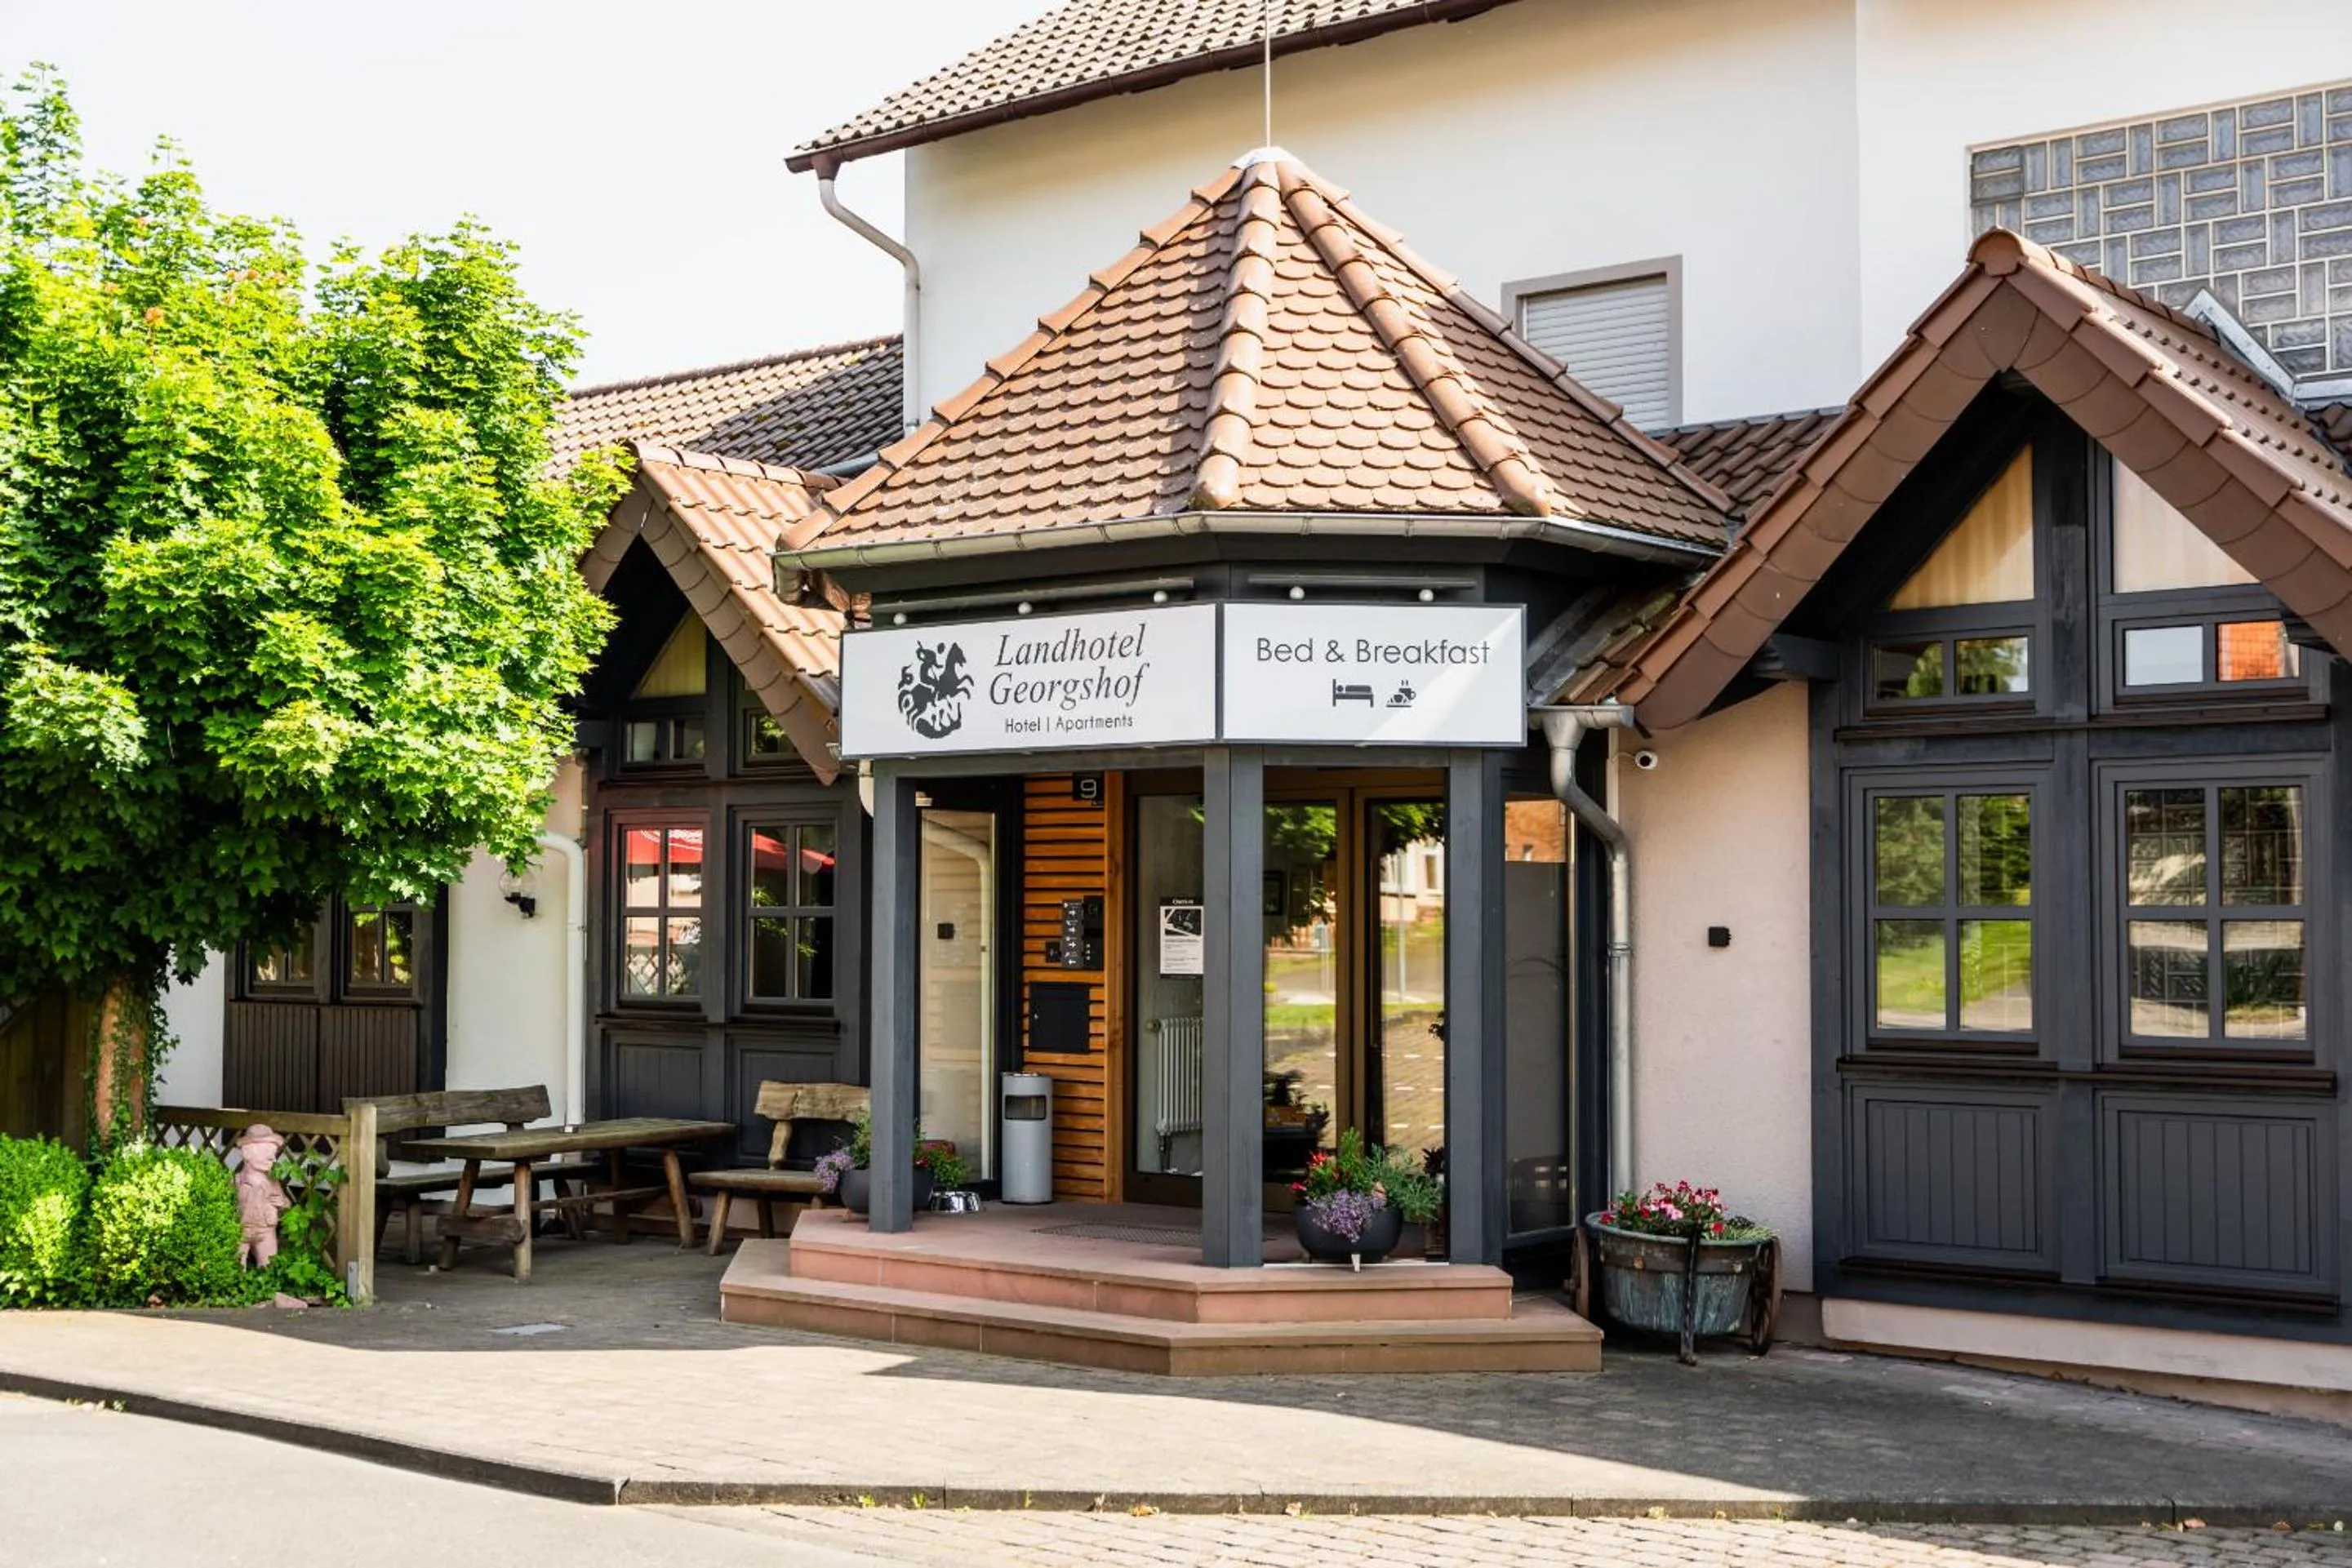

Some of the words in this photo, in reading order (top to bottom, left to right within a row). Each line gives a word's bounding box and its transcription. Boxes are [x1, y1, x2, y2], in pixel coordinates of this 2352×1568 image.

[994, 623, 1145, 667] Landhotel
[1256, 637, 1314, 663] Bed
[1324, 639, 1345, 663] &
[1356, 639, 1491, 664] Breakfast
[989, 662, 1150, 710] Georgshof
[1005, 717, 1041, 733] Hotel
[1056, 713, 1133, 733] Apartments
[1080, 779, 1097, 798] 9
